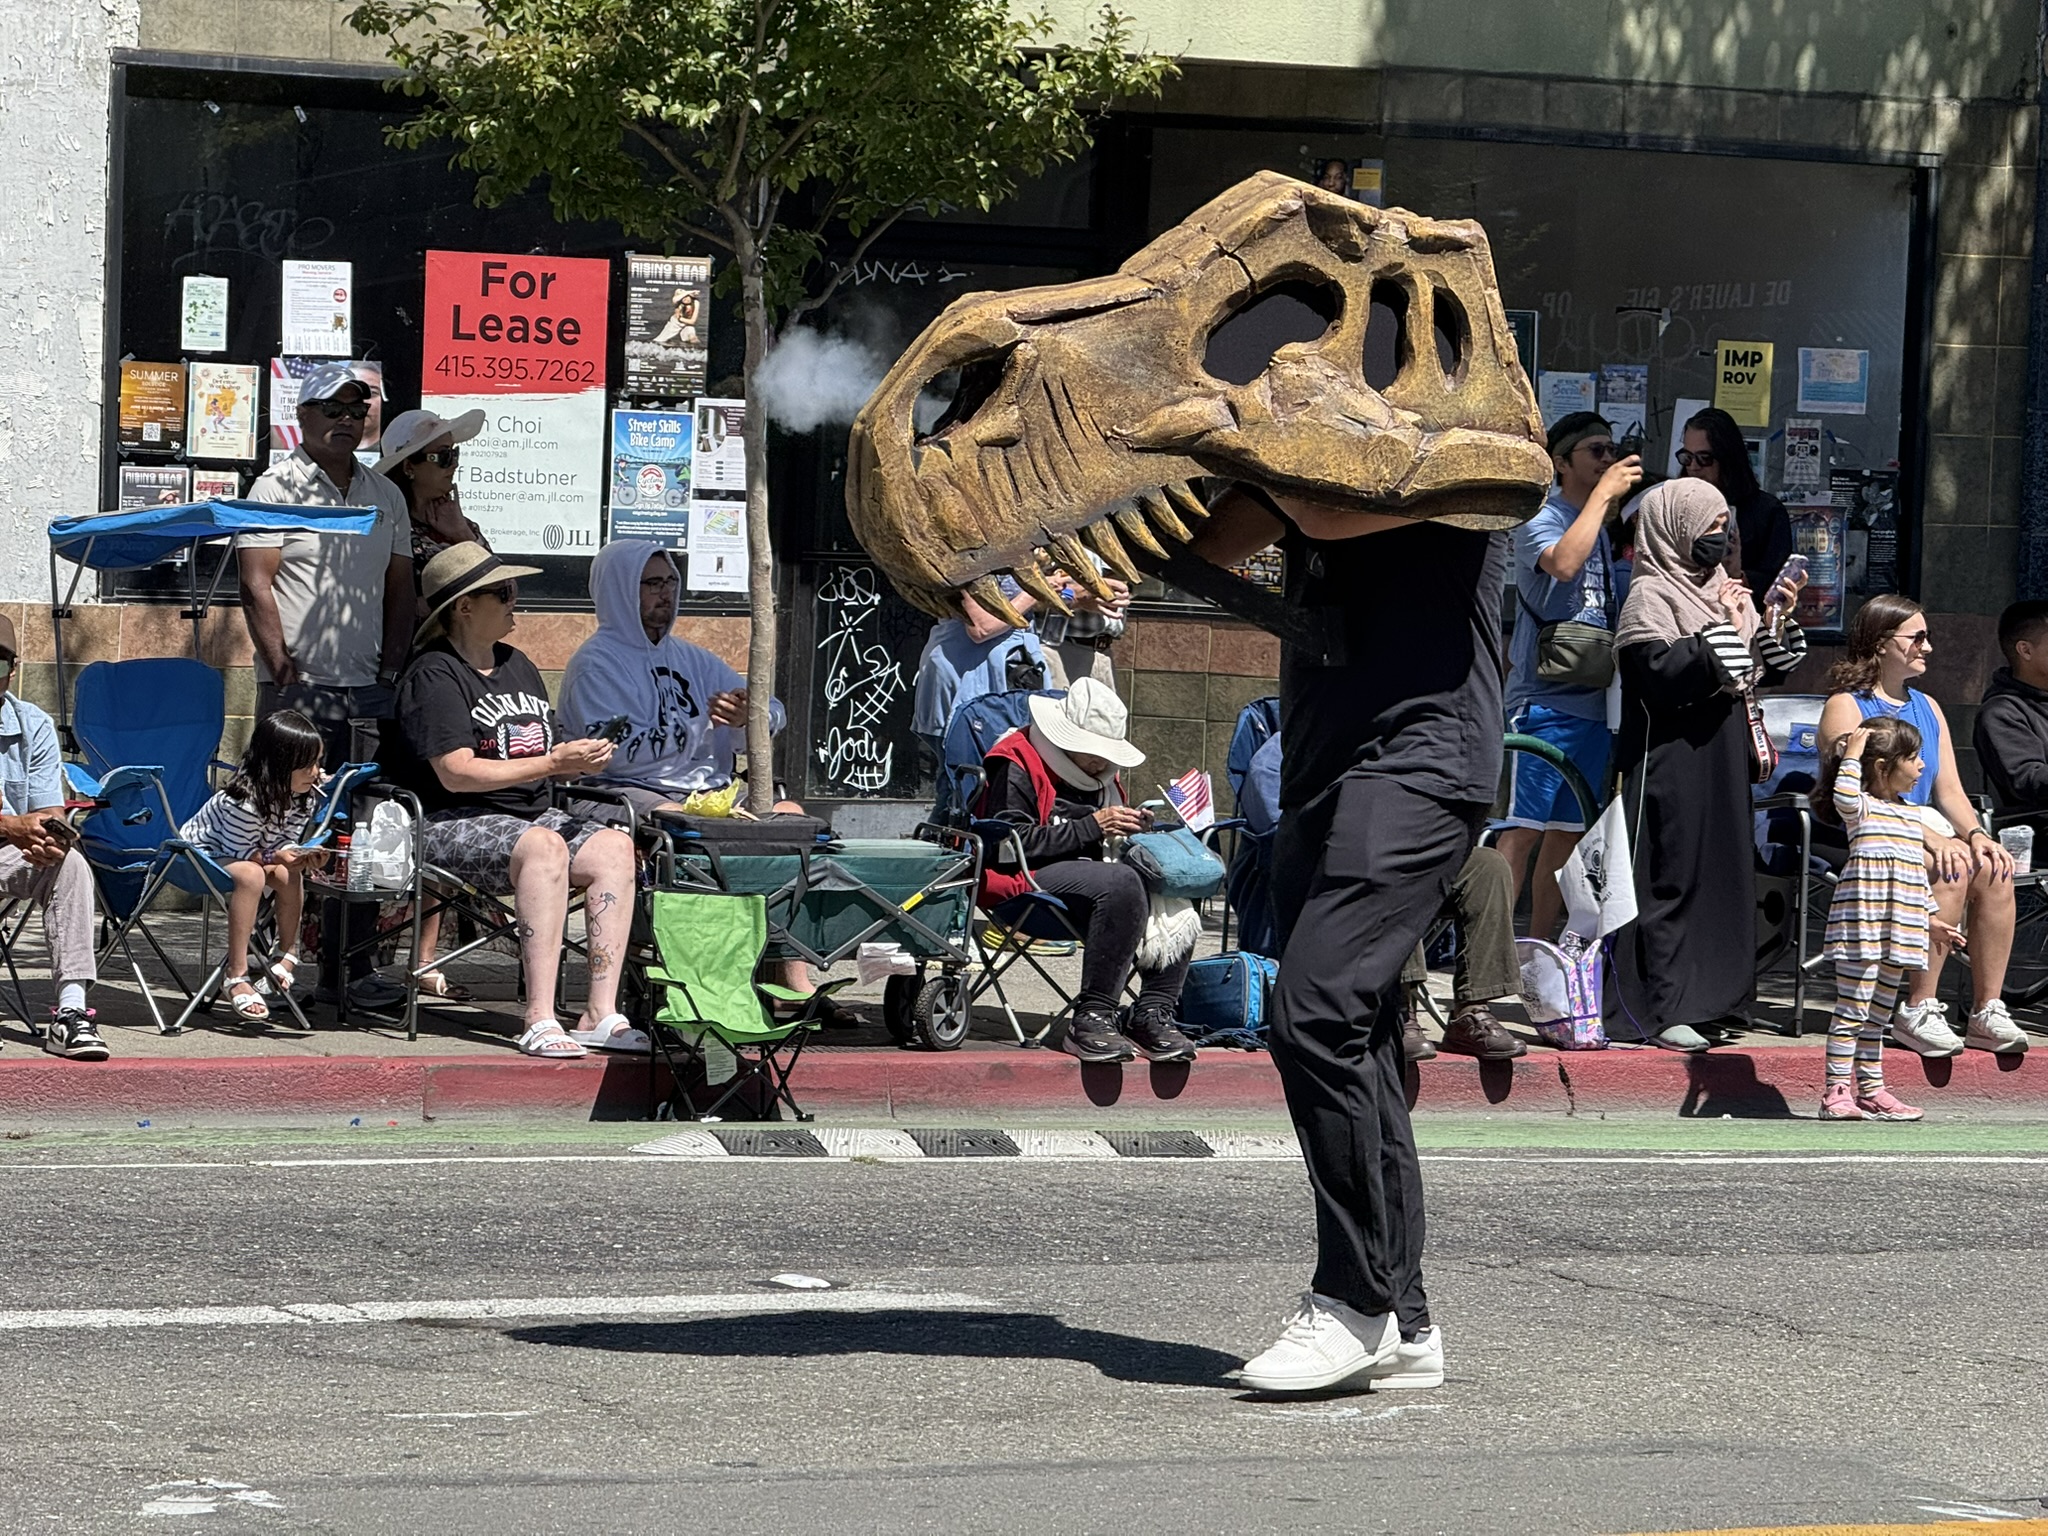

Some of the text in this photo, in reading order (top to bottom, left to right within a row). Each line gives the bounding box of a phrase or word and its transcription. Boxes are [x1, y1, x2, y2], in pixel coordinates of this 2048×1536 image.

[631, 262, 707, 275] RISING SEAS
[480, 261, 556, 300] For
[451, 304, 581, 345] Lease
[1724, 349, 1763, 368] IMP
[130, 369, 178, 382] SUMMER
[434, 354, 596, 384] 415.395.7262
[1723, 371, 1757, 385] ROV
[497, 416, 542, 434] Choi
[628, 418, 682, 434] Street Skills
[461, 437, 559, 450] .choi@am.jll.com
[630, 432, 676, 450] Bike Camp
[126, 472, 182, 481] RISING SEAS
[470, 466, 578, 485] Badstubner
[458, 489, 584, 504] adstubner@am.jll.com
[490, 528, 528, 537] Brokerage,
[565, 530, 595, 546] JLL
[480, 738, 496, 750] 20
